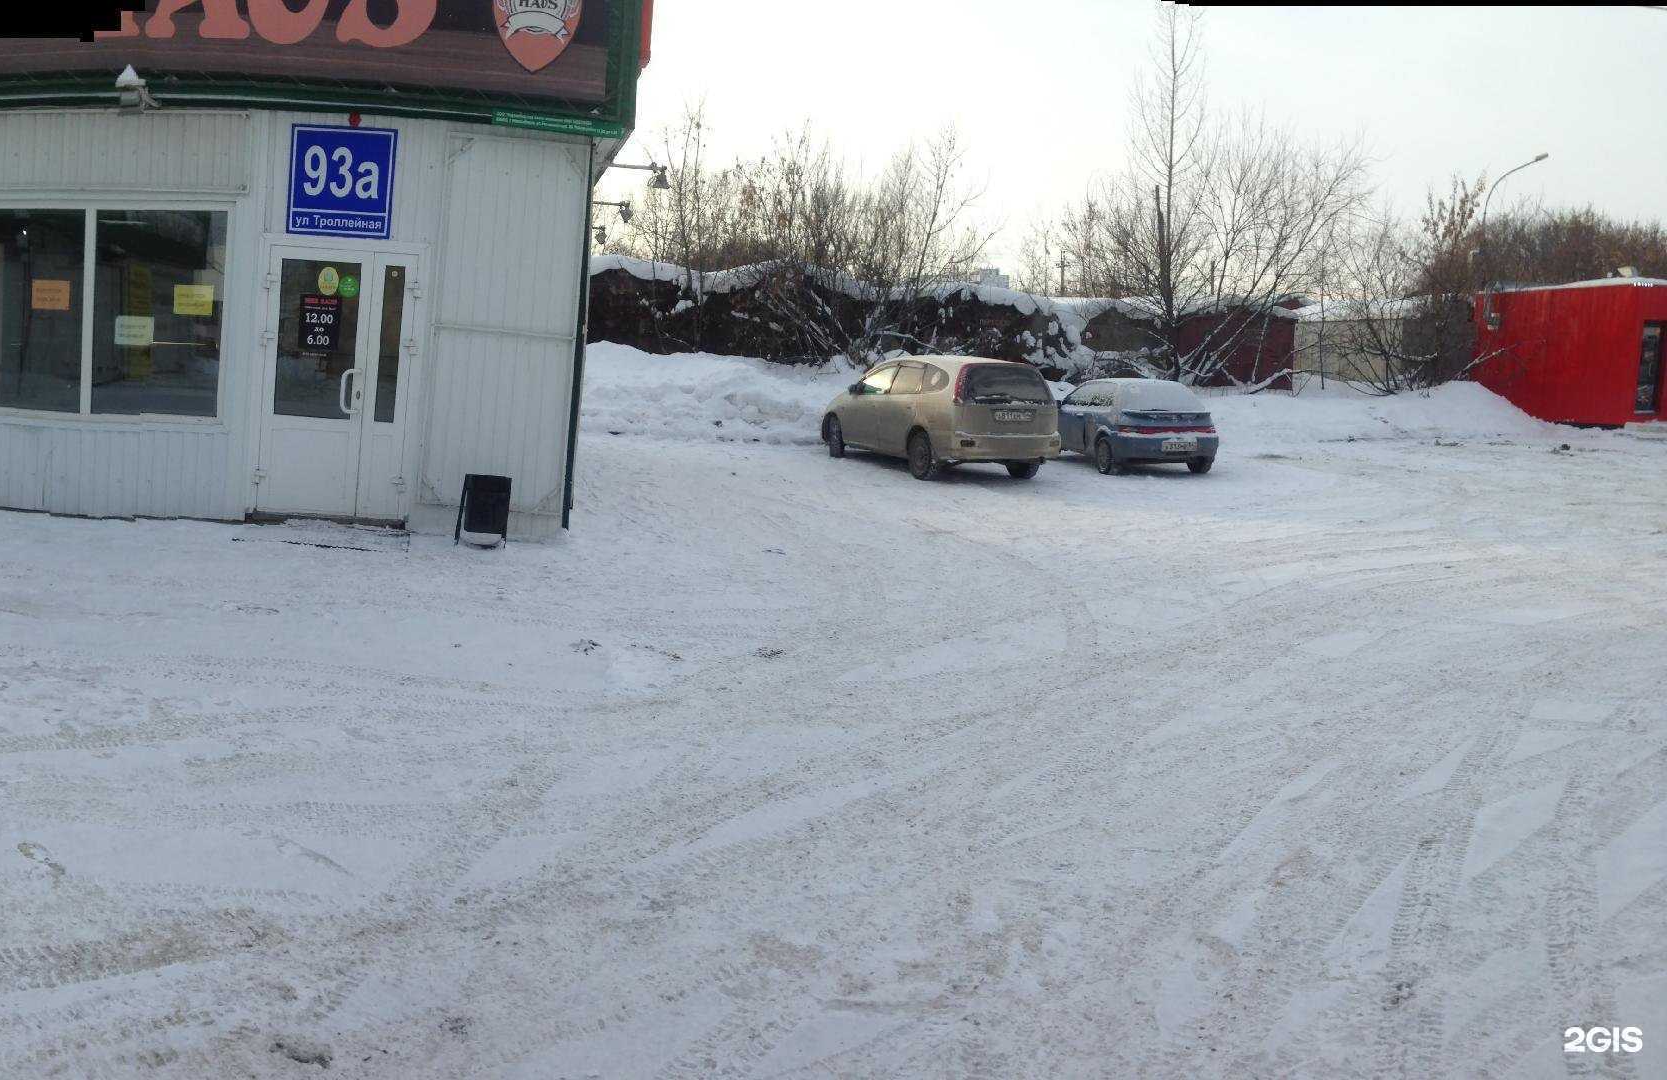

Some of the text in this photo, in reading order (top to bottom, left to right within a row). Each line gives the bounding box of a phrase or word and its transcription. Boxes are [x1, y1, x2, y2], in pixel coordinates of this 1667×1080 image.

[303, 145, 379, 199] 93а
[295, 214, 382, 229] ул Троллейная
[305, 312, 334, 324] 12.00
[306, 334, 330, 346] 6.00
